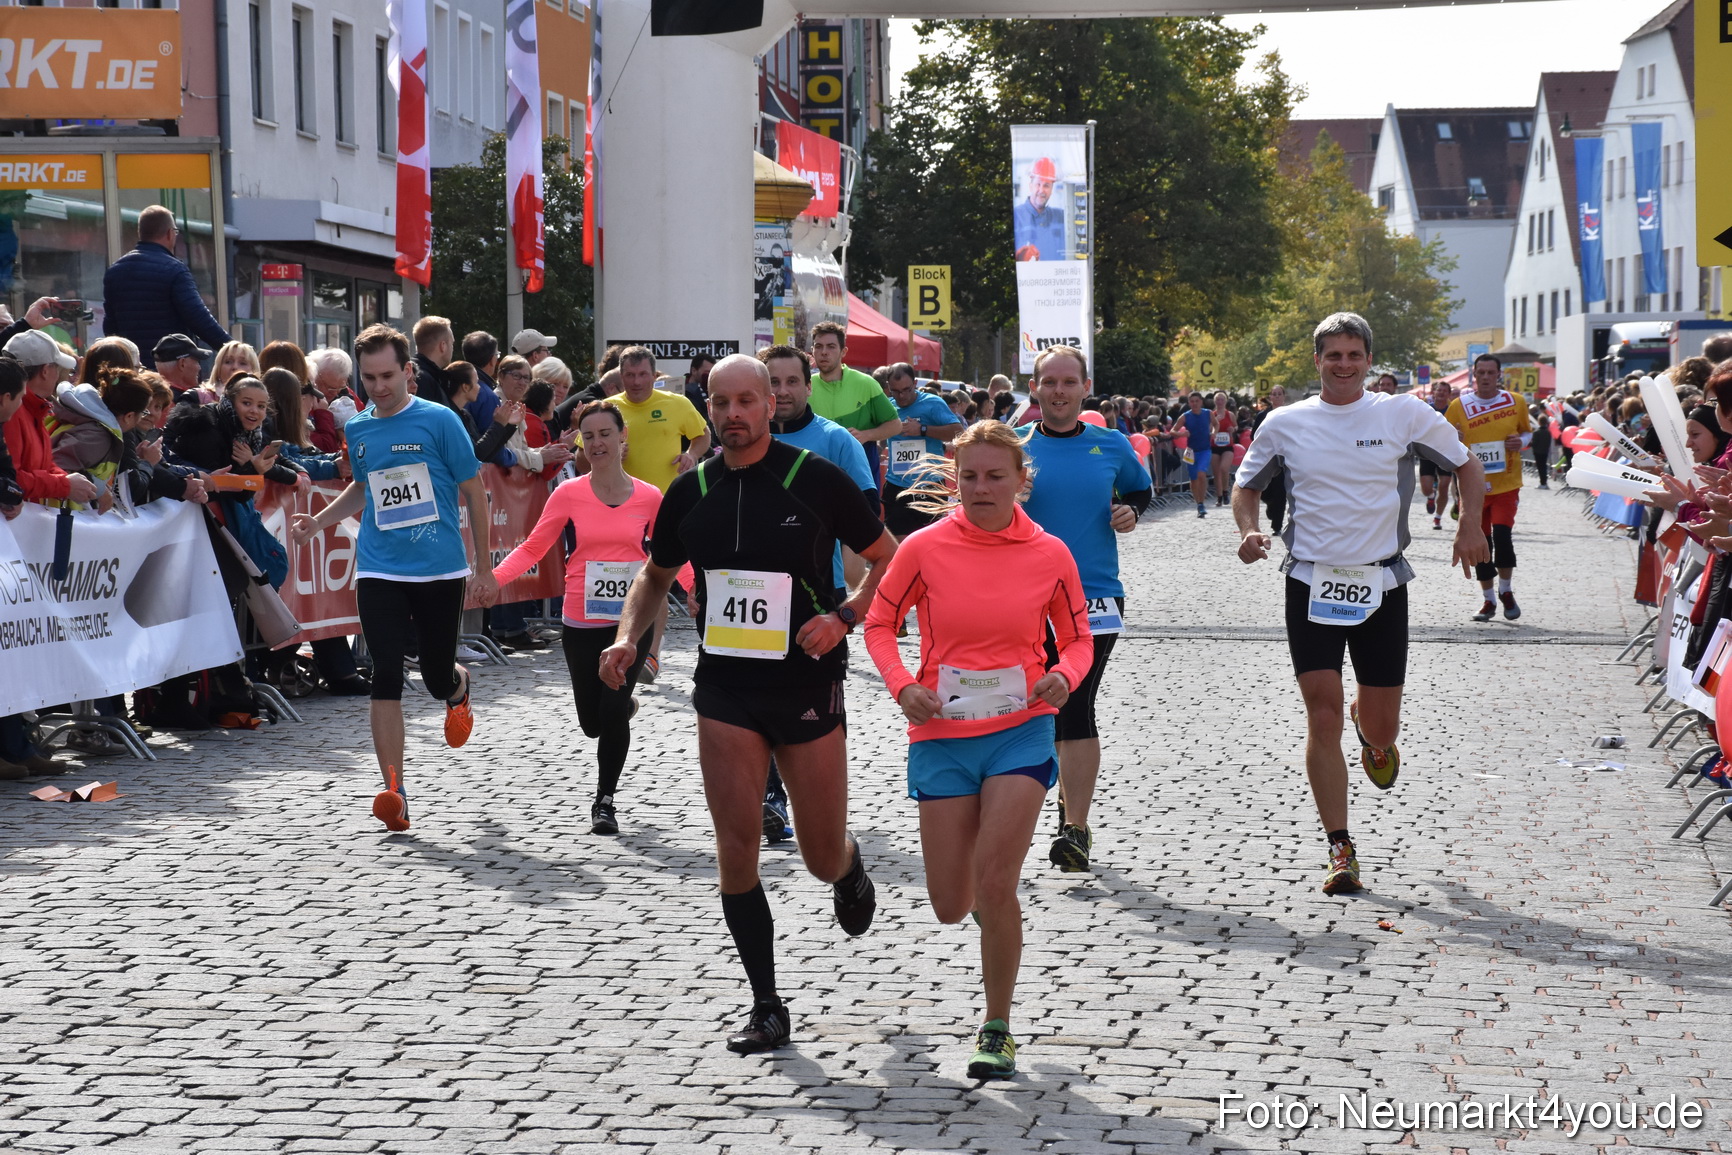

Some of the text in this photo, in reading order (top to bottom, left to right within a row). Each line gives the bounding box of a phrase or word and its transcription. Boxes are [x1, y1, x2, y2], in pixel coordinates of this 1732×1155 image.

[913, 268, 946, 280] Block
[919, 285, 941, 316] B
[1200, 360, 1213, 377] C
[1260, 379, 1269, 391] D
[1525, 374, 1536, 388] D
[1469, 410, 1517, 429] MAX BÖGL
[391, 444, 422, 452] BOCK
[1618, 438, 1639, 456] swn
[896, 450, 921, 462] 2907
[1476, 451, 1500, 462] 2611
[381, 482, 422, 507] 2941
[594, 580, 634, 598] 293
[734, 578, 765, 587] BOCK
[1320, 581, 1372, 604] 2562
[723, 597, 768, 625] 416
[1331, 606, 1357, 617] Roland
[968, 677, 999, 686] BOCK
